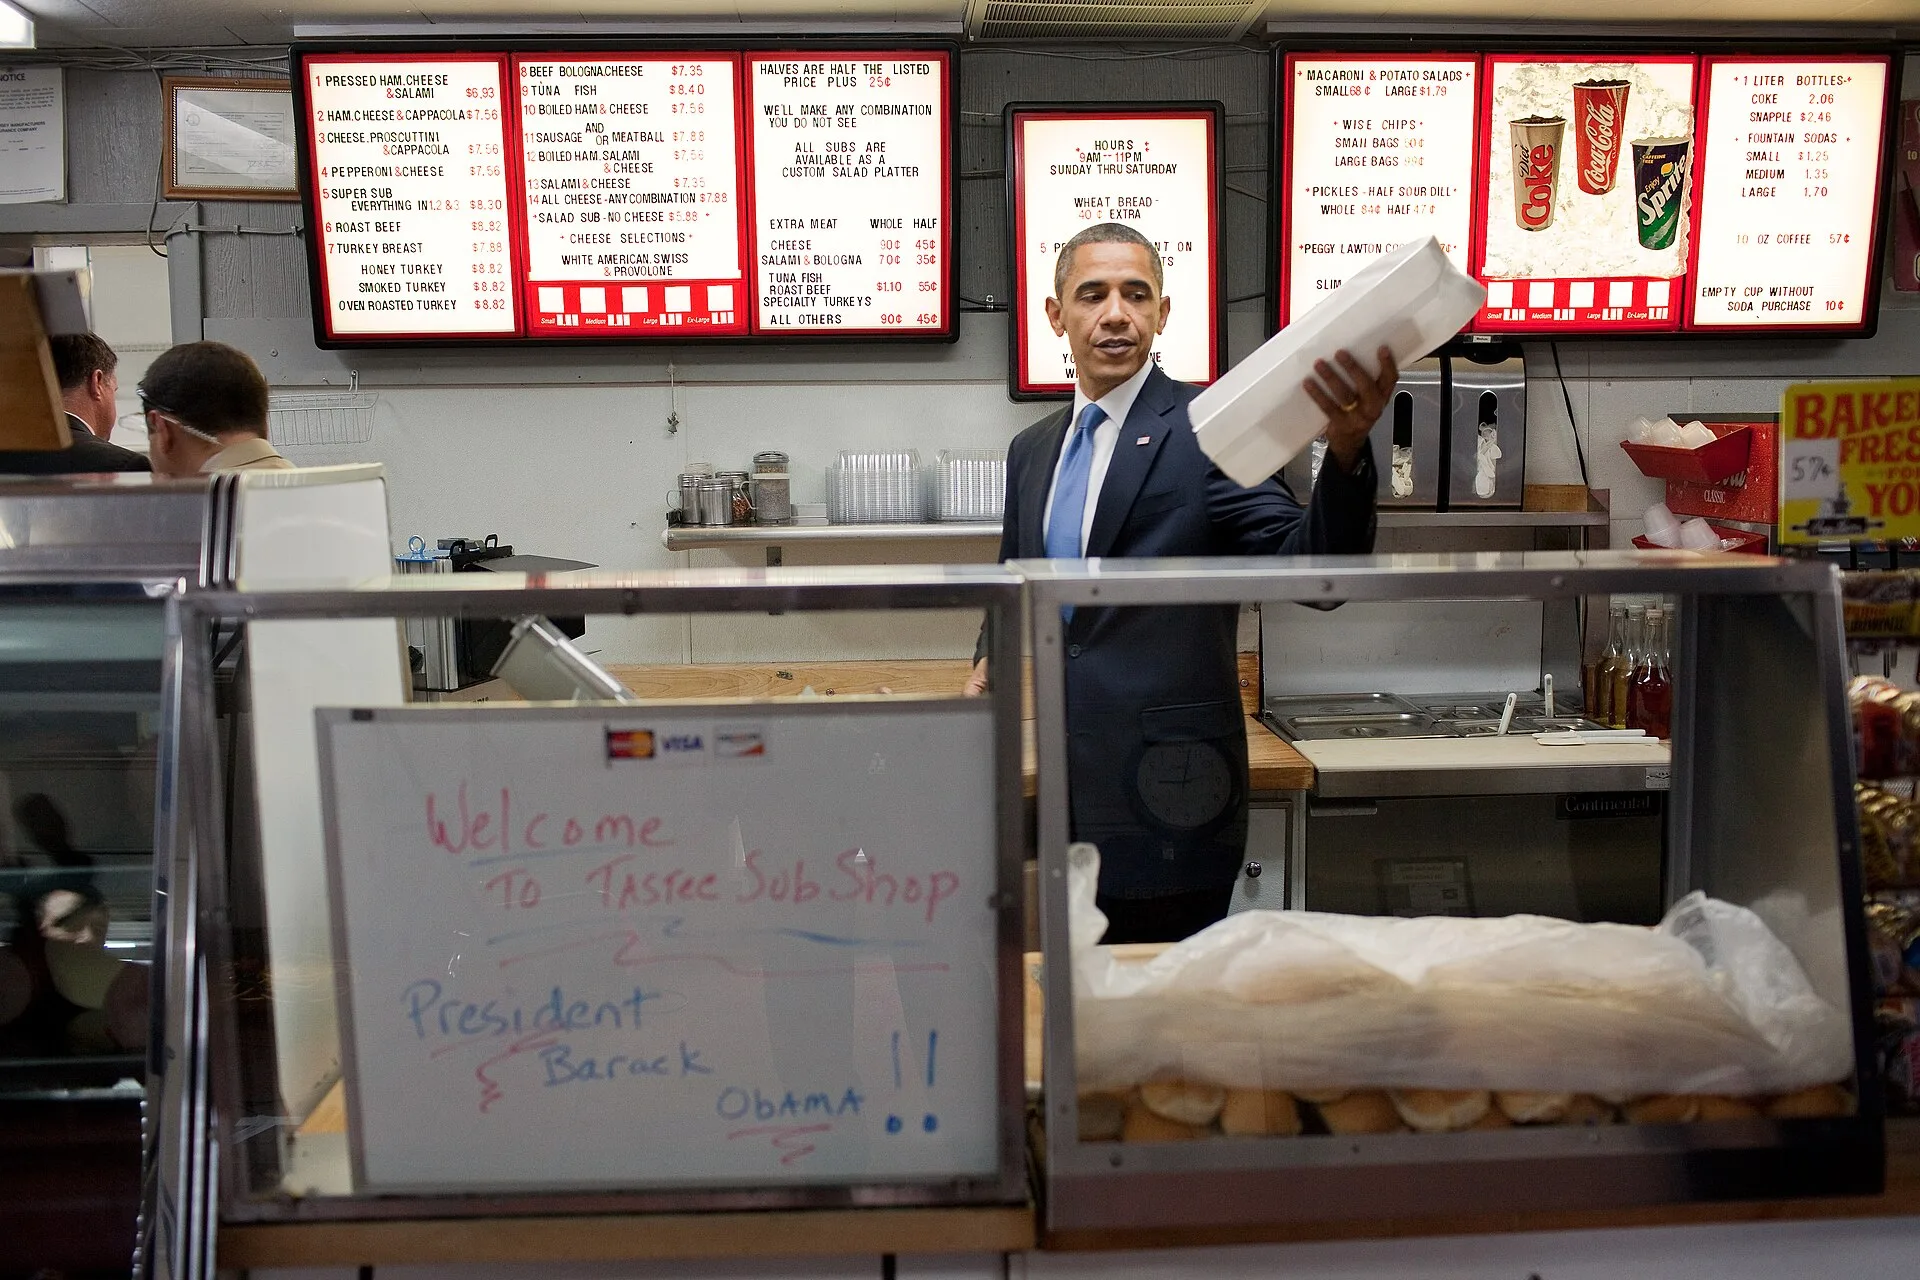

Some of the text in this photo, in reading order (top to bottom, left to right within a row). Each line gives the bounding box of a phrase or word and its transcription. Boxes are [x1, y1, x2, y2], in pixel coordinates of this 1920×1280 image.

[521, 66, 554, 77] 8 BEEF
[760, 64, 930, 75] HALVES ARE HALF THE LISTED
[325, 75, 377, 87] PRESSED
[1307, 70, 1463, 81] MACARONI & POTATO SALADS
[1753, 76, 1784, 86] LITER
[784, 77, 857, 88] PRICE PLUS
[522, 84, 704, 96] 9 TUNA FISH $8.40
[1385, 86, 1417, 97] LARGE
[1752, 94, 1834, 105] COKE 2.06
[524, 104, 649, 115] 10 BOILED HAM CHEESE
[801, 105, 932, 116] MAKE ANY COMBINATION
[769, 117, 857, 128] YOU DO NOT SEE
[1750, 112, 1792, 122] SNAPPLE
[585, 123, 604, 133] AND
[1343, 120, 1416, 130] WISE CHIPS
[536, 132, 665, 146] SAUSAGE OR MEATBALL
[1373, 138, 1399, 148] BAGS
[1748, 133, 1837, 143] FOUNTAIN SODAS
[795, 142, 886, 153] ALL SUBS ARE
[1095, 140, 1134, 151] HOURS
[538, 151, 572, 162] BOILED
[795, 154, 885, 165] AVAILABLE AS A
[1335, 156, 1399, 167] LARGE BAGS
[1746, 152, 1780, 161] SMALL
[321, 167, 328, 177] 4
[782, 166, 919, 178] CUSTOM SALAD PLATTER
[1050, 164, 1177, 175] SUNDAY THRU SATURDAY
[1745, 169, 1785, 179] MEDIUM
[331, 188, 393, 199] SUPER SUB
[1313, 187, 1451, 197] PICKLES SOUR DILL
[1638, 155, 1686, 226] Sprite
[1742, 187, 1828, 198] LARGE 1.70
[529, 193, 696, 205] 14 ALL COMBINATION
[1074, 197, 1110, 208] WHEAT
[351, 199, 502, 211] EVERYTHING $8.30
[1321, 205, 1410, 215] WHOLE HALF
[624, 211, 664, 222] CHEESE
[1109, 209, 1141, 219] EXTRA
[335, 222, 401, 233] ROAST BEEF
[770, 218, 937, 229] EXTRA MEAT WHOLE HALF
[570, 232, 685, 244] CHEESE SELECTIONS
[1758, 234, 1811, 244] OZ COFFEE
[337, 243, 423, 254] TURKEY BREAST
[771, 240, 812, 250] CHEESE
[1178, 242, 1192, 252] ON
[1340, 243, 1382, 254] LAWTON
[561, 255, 593, 265] WHITE
[762, 254, 862, 265] SALAMI BOLOGNA
[362, 264, 443, 275] HONEY TURKEY
[614, 266, 673, 276] PROVOLONE
[769, 273, 822, 283] TUNA FISH
[359, 282, 446, 293] SMOKED TURKEY
[770, 282, 902, 295] ROAST BEEF $1.10
[1316, 279, 1342, 290] SLIM
[1702, 287, 1814, 297] EMPTY CUP WITHOUT
[339, 300, 457, 311] OVEN ROASTED TURKEY
[764, 297, 872, 307] SPECIALTY TURKEYS
[1728, 301, 1811, 312] SODA PURCHASE
[541, 317, 556, 325] Small
[770, 314, 842, 325] ALL OTHERS
[1794, 391, 1920, 439] BAKE
[1865, 481, 1920, 517] YO
[662, 735, 704, 751] VISA
[424, 782, 676, 855] Welcome
[405, 979, 663, 1040] President
[540, 1042, 714, 1088] Barack
